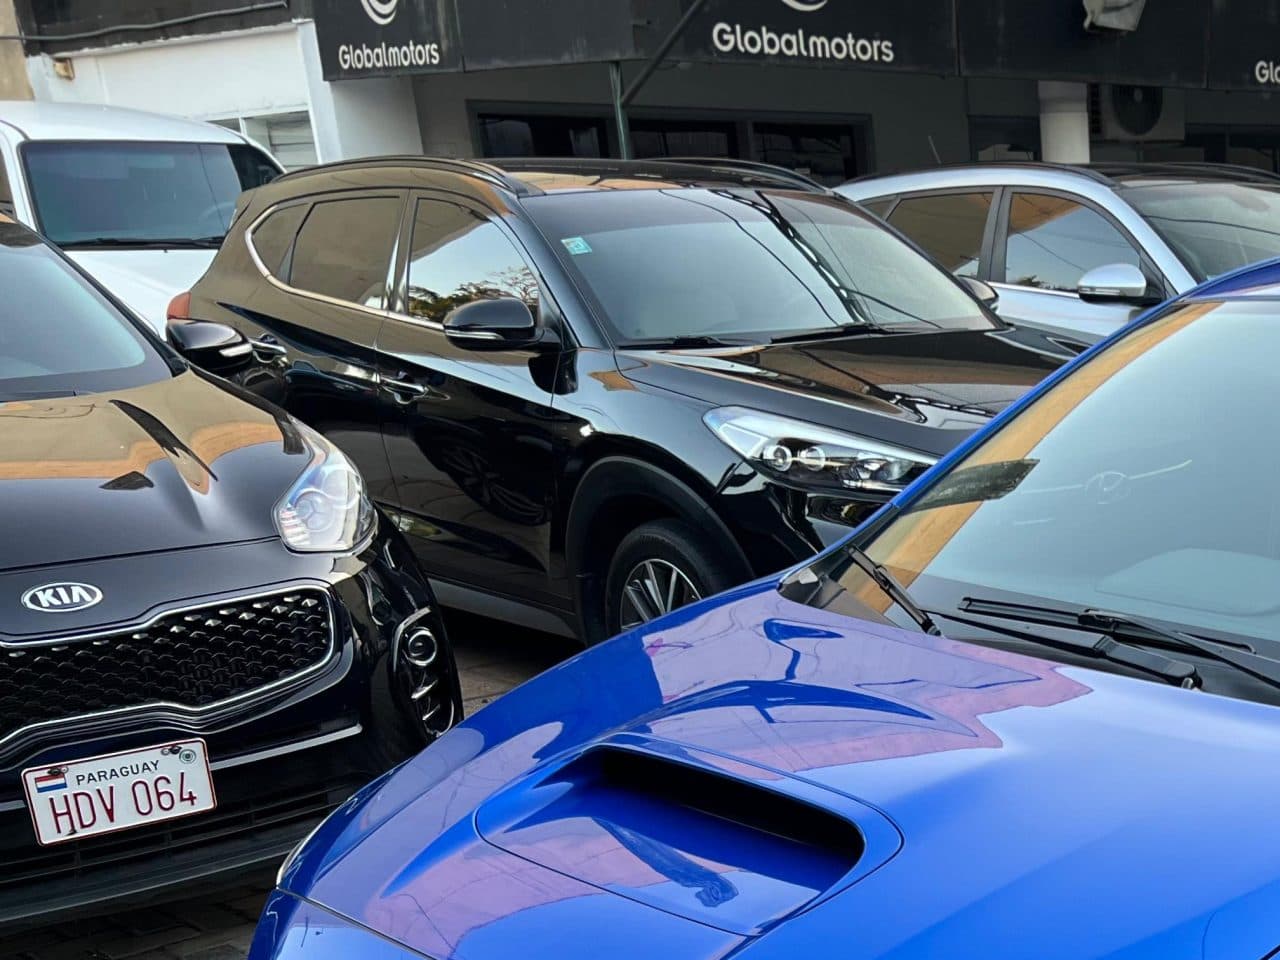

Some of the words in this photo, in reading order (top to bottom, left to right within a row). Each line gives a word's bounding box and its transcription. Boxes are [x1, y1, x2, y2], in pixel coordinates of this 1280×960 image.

[338, 41, 440, 70] Globalmotors
[712, 22, 895, 62] Globalmotors
[36, 586, 88, 606] KIA
[76, 760, 160, 786] PARAGUAY
[48, 785, 116, 834] HDV
[131, 772, 197, 816] 064
